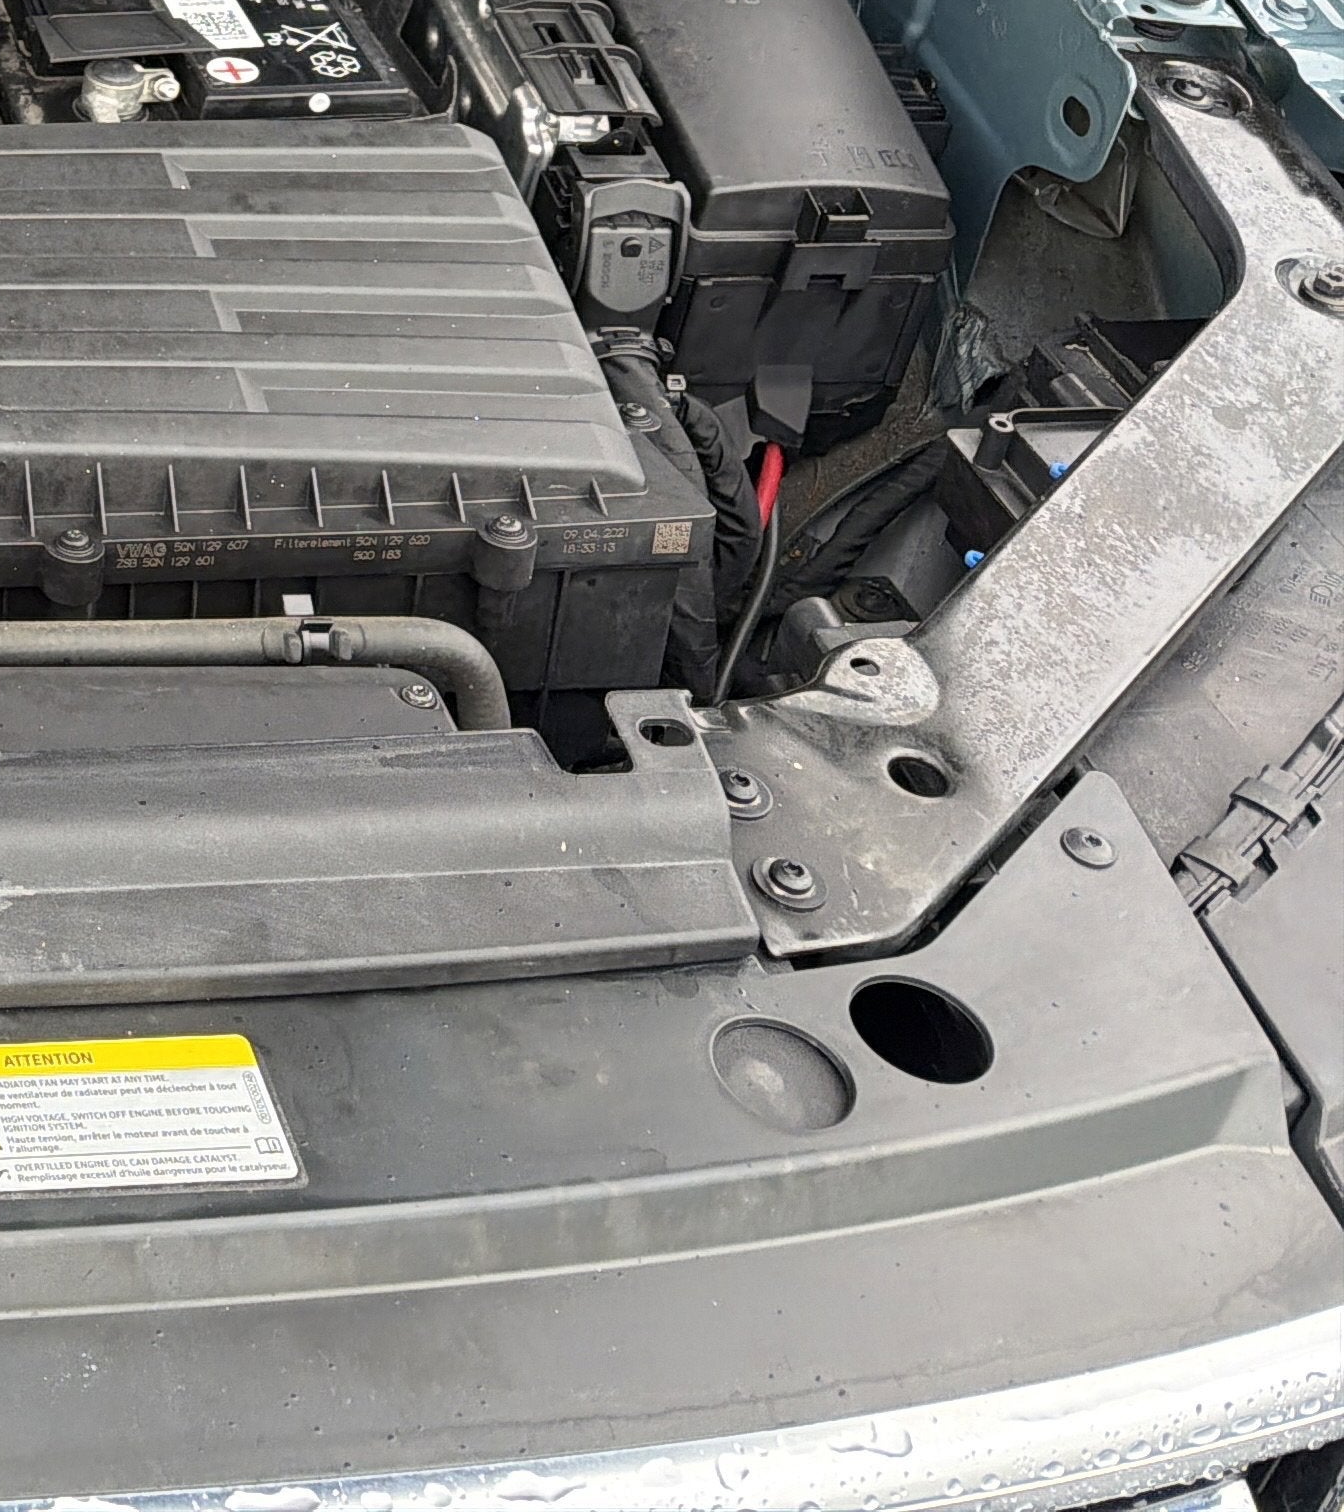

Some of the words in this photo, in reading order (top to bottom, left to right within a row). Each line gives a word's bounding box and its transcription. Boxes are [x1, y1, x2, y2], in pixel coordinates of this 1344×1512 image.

[263, 31, 281, 46] Pb
[116, 542, 167, 558] VWAG
[202, 540, 223, 552] 129
[226, 539, 249, 551] 607
[274, 537, 351, 550] Filterelement
[384, 535, 404, 546] 129
[408, 534, 431, 546] 620
[170, 555, 191, 567] 129
[195, 554, 216, 566] 601
[4, 1051, 94, 1068] ATTENTION
[38, 1078, 58, 1087] FAN
[58, 1078, 79, 1086] MAY
[80, 1076, 109, 1085] START
[123, 1075, 142, 1083] ANY
[143, 1074, 169, 1082] TIME.
[0, 1114, 25, 1123] HIGH
[70, 1111, 107, 1120] SWITCH
[108, 1110, 126, 1119] OFF
[127, 1109, 164, 1118] ENGINE
[164, 1107, 202, 1116] BEFORE
[202, 1105, 252, 1114] TOUCHING
[2, 1123, 46, 1132] IGNITION
[47, 1122, 87, 1131] SYSTEM.
[13, 1161, 72, 1172] OVERFILLED
[73, 1160, 110, 1169] ENGINE
[111, 1159, 128, 1167] OIL
[128, 1158, 149, 1166] CAN
[150, 1156, 192, 1165] DAMAGE
[192, 1153, 240, 1163] CATALYST.
